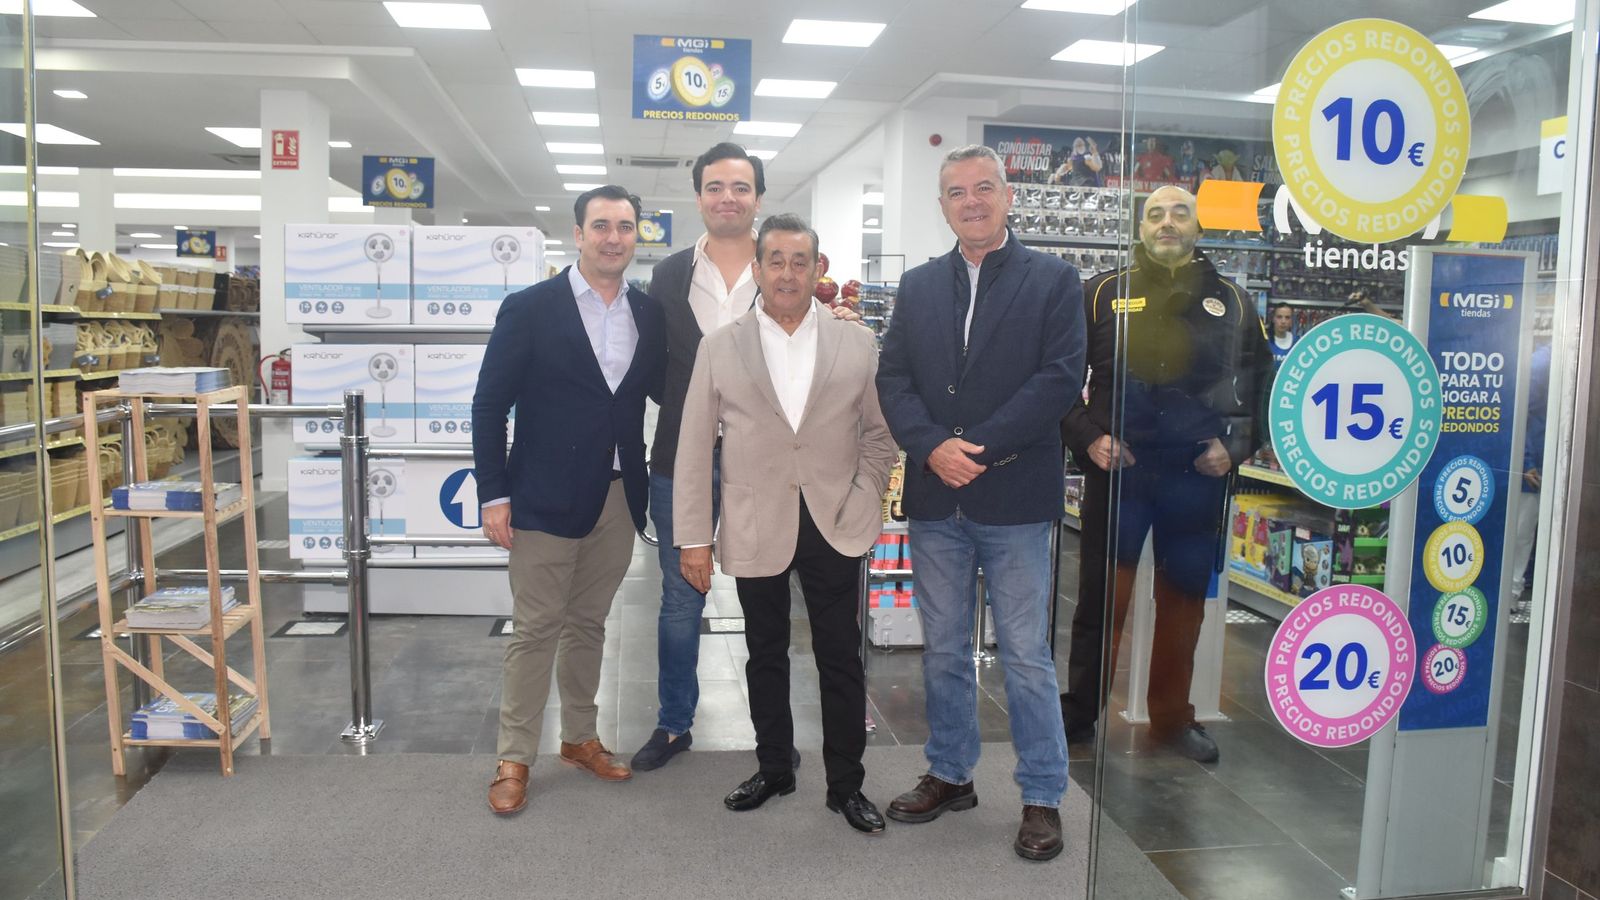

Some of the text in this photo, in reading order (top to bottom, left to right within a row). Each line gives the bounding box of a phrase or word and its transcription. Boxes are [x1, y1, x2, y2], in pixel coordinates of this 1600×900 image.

[1284, 29, 1462, 134] PRECIOS REDONDOS
[643, 109, 740, 121] PRECIOS REDONDOS
[1322, 96, 1425, 167] 10€
[997, 141, 1052, 156] CONQUISTAR
[1009, 155, 1050, 171] MUNDO
[1283, 133, 1350, 227] PRECIOS
[1356, 145, 1460, 233] REDONDOS
[1303, 239, 1410, 271] tiendas
[1453, 292, 1500, 309] MGi
[1461, 309, 1491, 318] tiendas
[1279, 324, 1435, 410] PRECIOS REDONDOS
[1441, 351, 1505, 372] TODO
[1440, 373, 1504, 389] PARA TU
[1441, 390, 1501, 403] HOGAR A
[1311, 383, 1405, 441] 15€
[1441, 406, 1501, 421] PRECIOS
[1279, 418, 1434, 501] PRECIOS REDONDOS
[1440, 458, 1489, 498] PRECIOS REDONDOS
[1452, 477, 1475, 508] 5€
[1436, 484, 1449, 519] PRECIOS
[1275, 592, 1409, 666] PRECIOS REDONDOS
[1447, 603, 1471, 629] 15€
[1299, 642, 1381, 691] 20€
[1274, 671, 1407, 740] PRECIOS REDONDOS
